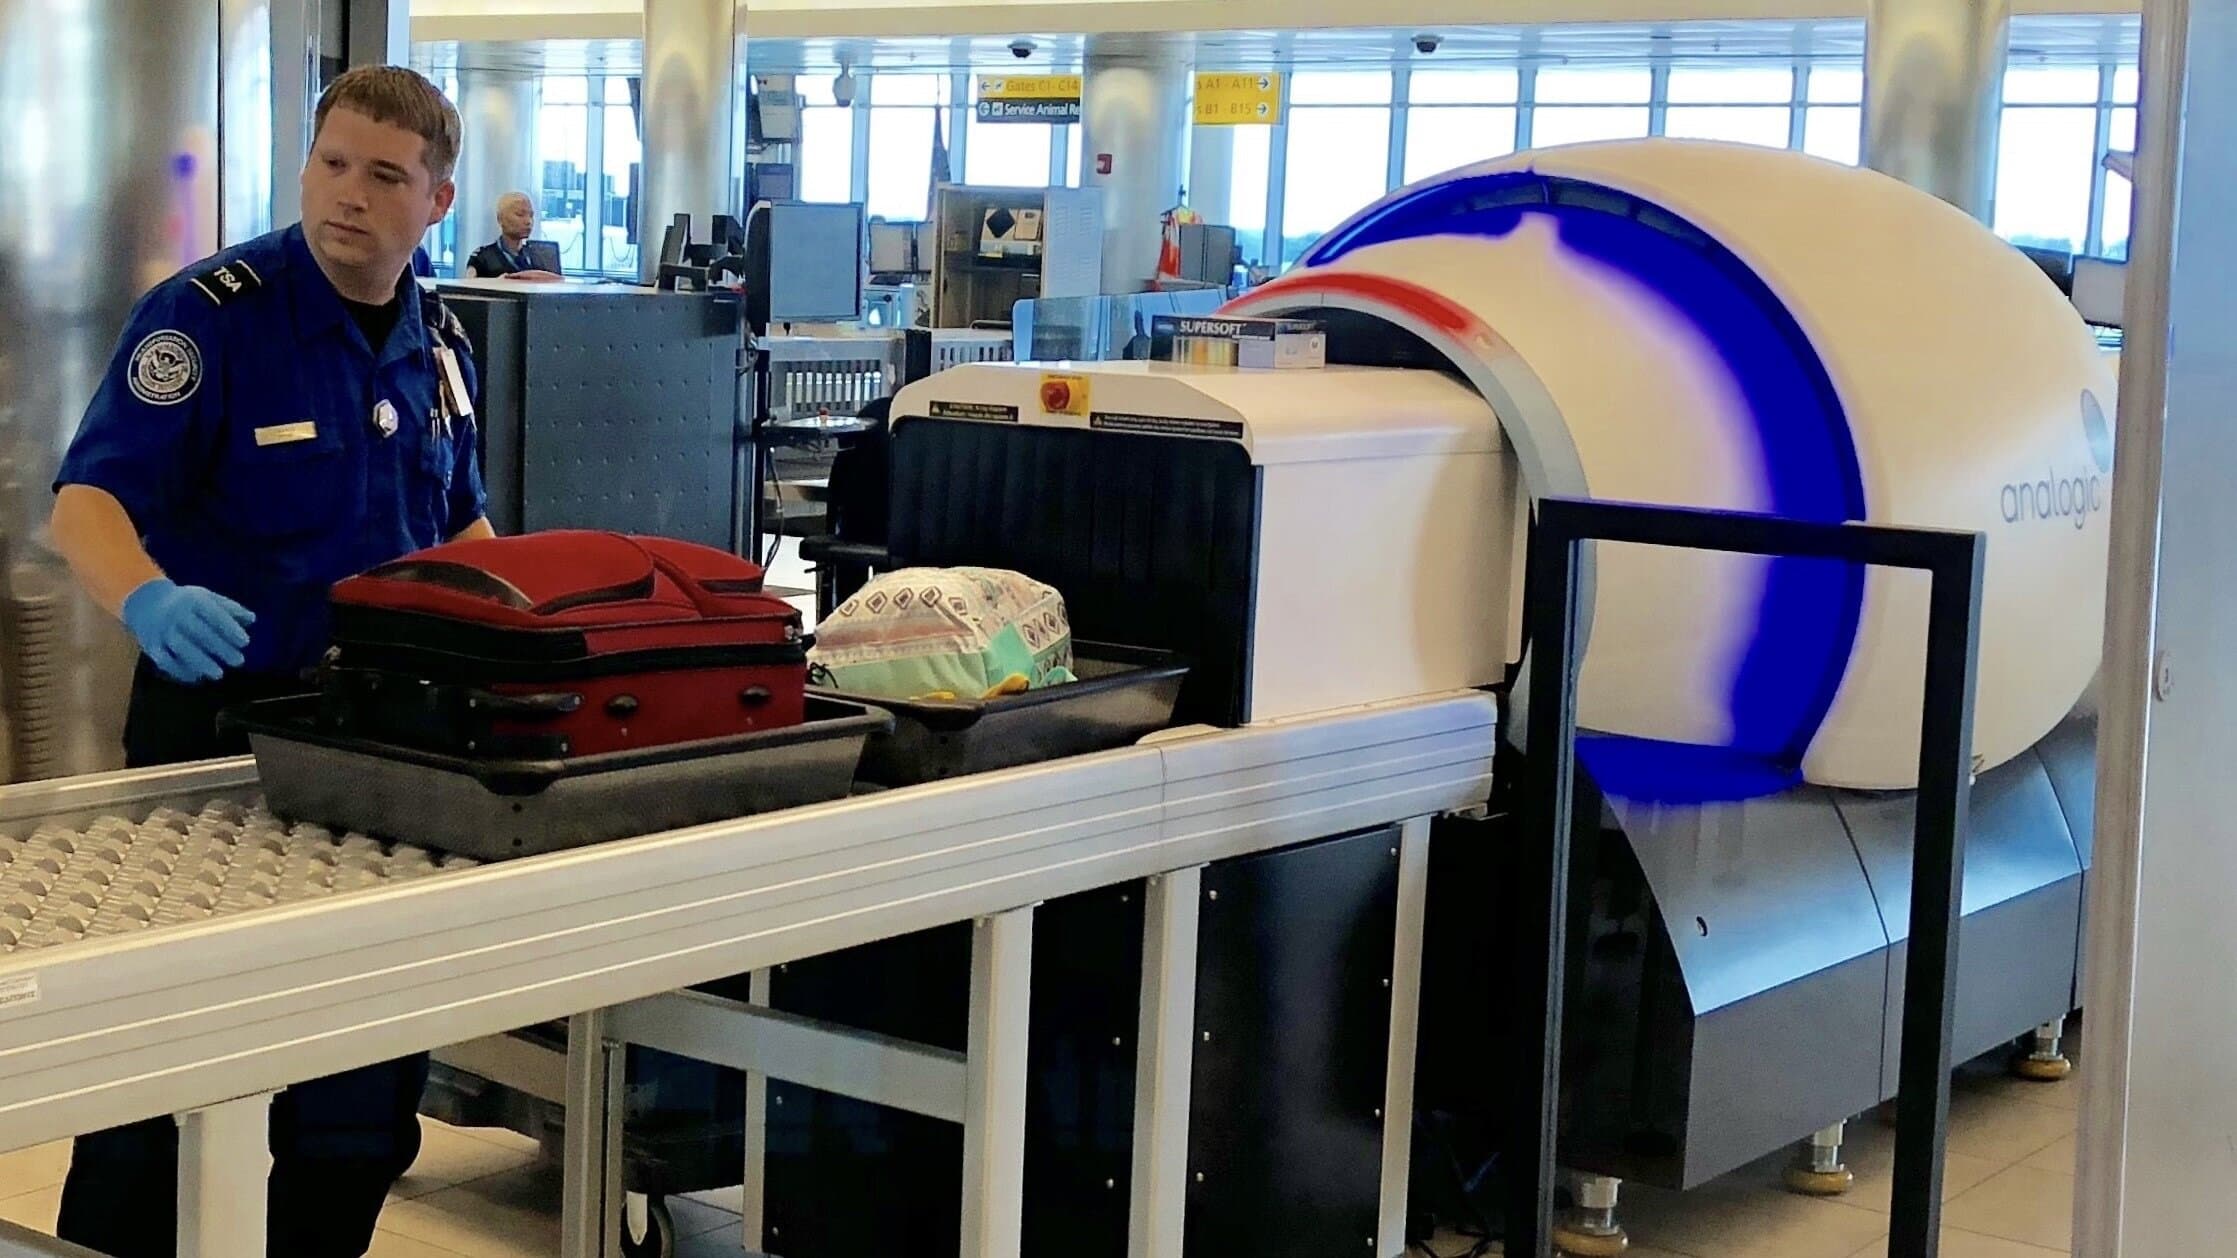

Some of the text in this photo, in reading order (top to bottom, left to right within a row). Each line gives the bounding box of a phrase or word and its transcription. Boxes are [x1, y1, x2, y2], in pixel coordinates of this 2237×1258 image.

[1006, 79, 1035, 91] Gates
[1058, 79, 1078, 91] C14
[1206, 78, 1220, 89] A1
[1005, 102, 1035, 115] Service
[1036, 102, 1068, 115] Animal
[214, 266, 242, 292] TSA
[1180, 320, 1241, 335] SUPERSOFT
[2000, 465, 2101, 531] analogic
